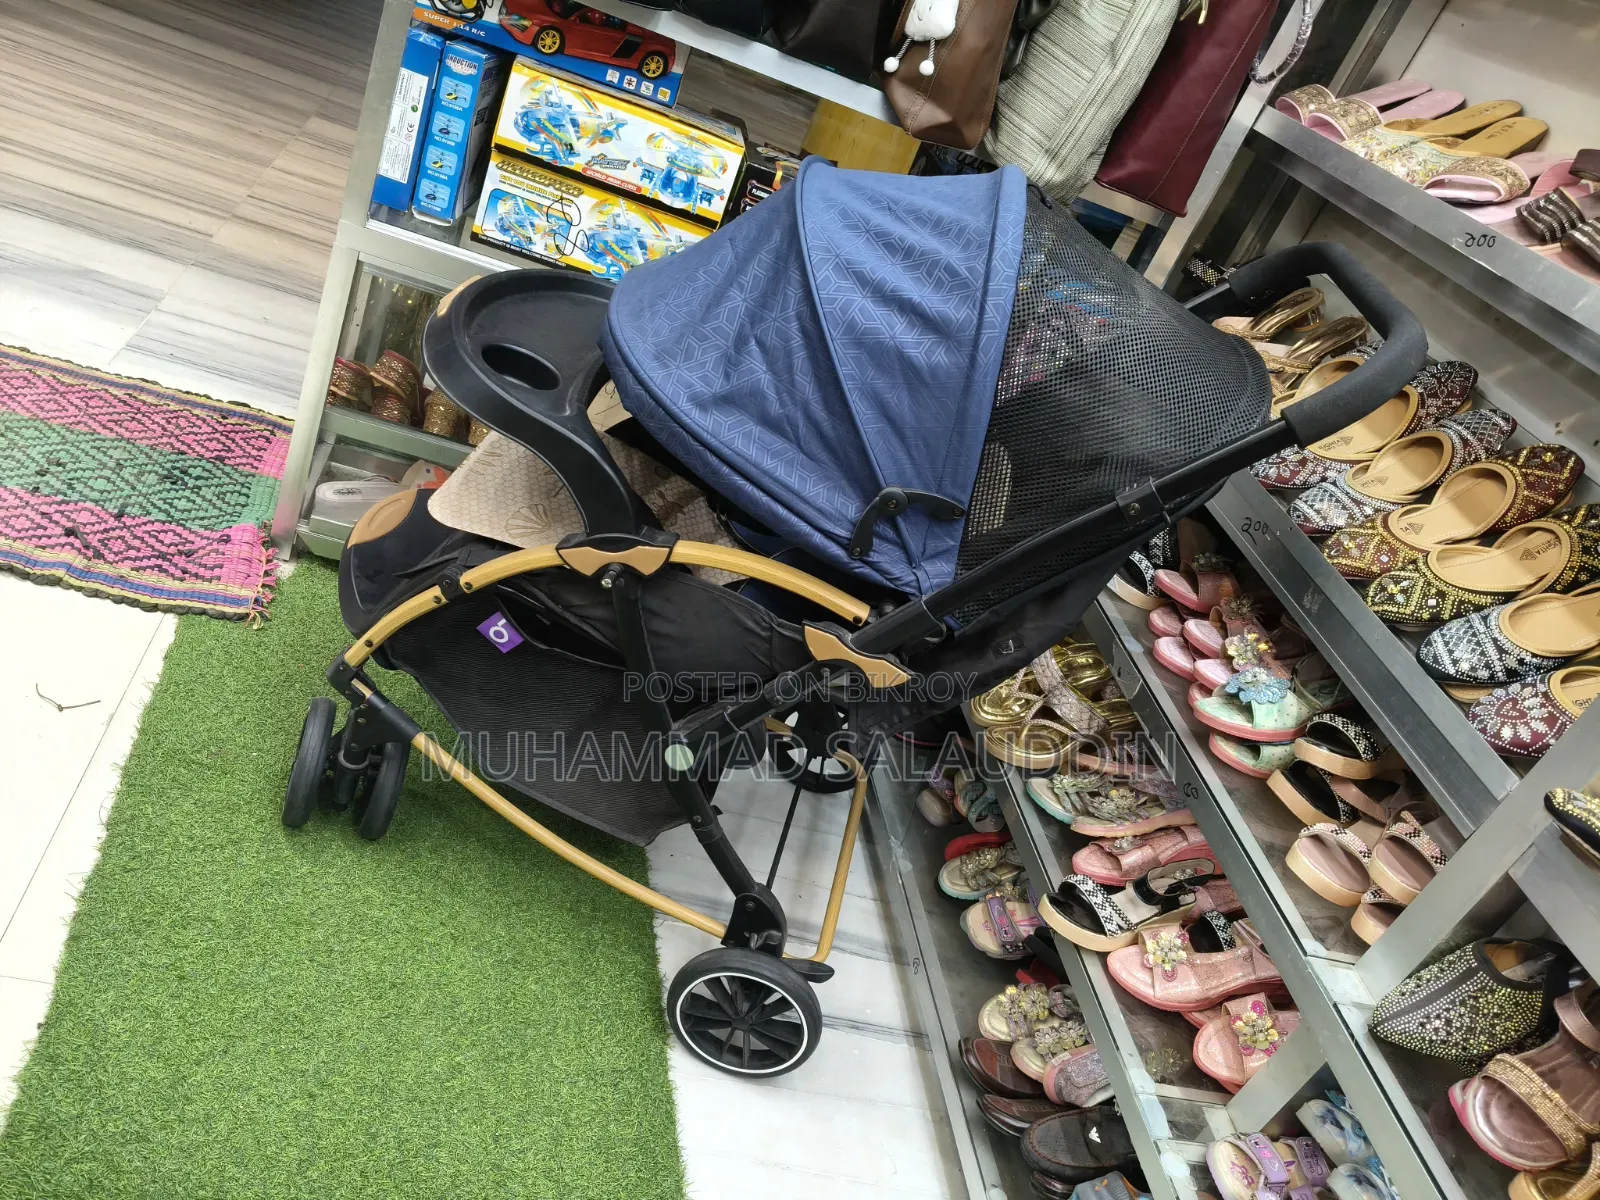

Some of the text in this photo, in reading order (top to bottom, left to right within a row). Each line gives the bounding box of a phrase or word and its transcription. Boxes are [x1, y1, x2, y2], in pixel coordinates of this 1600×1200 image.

[423, 11, 450, 25] SUPER
[471, 27, 486, 37] R/C
[447, 54, 479, 70] INDUCTION
[586, 169, 607, 180] WORLD
